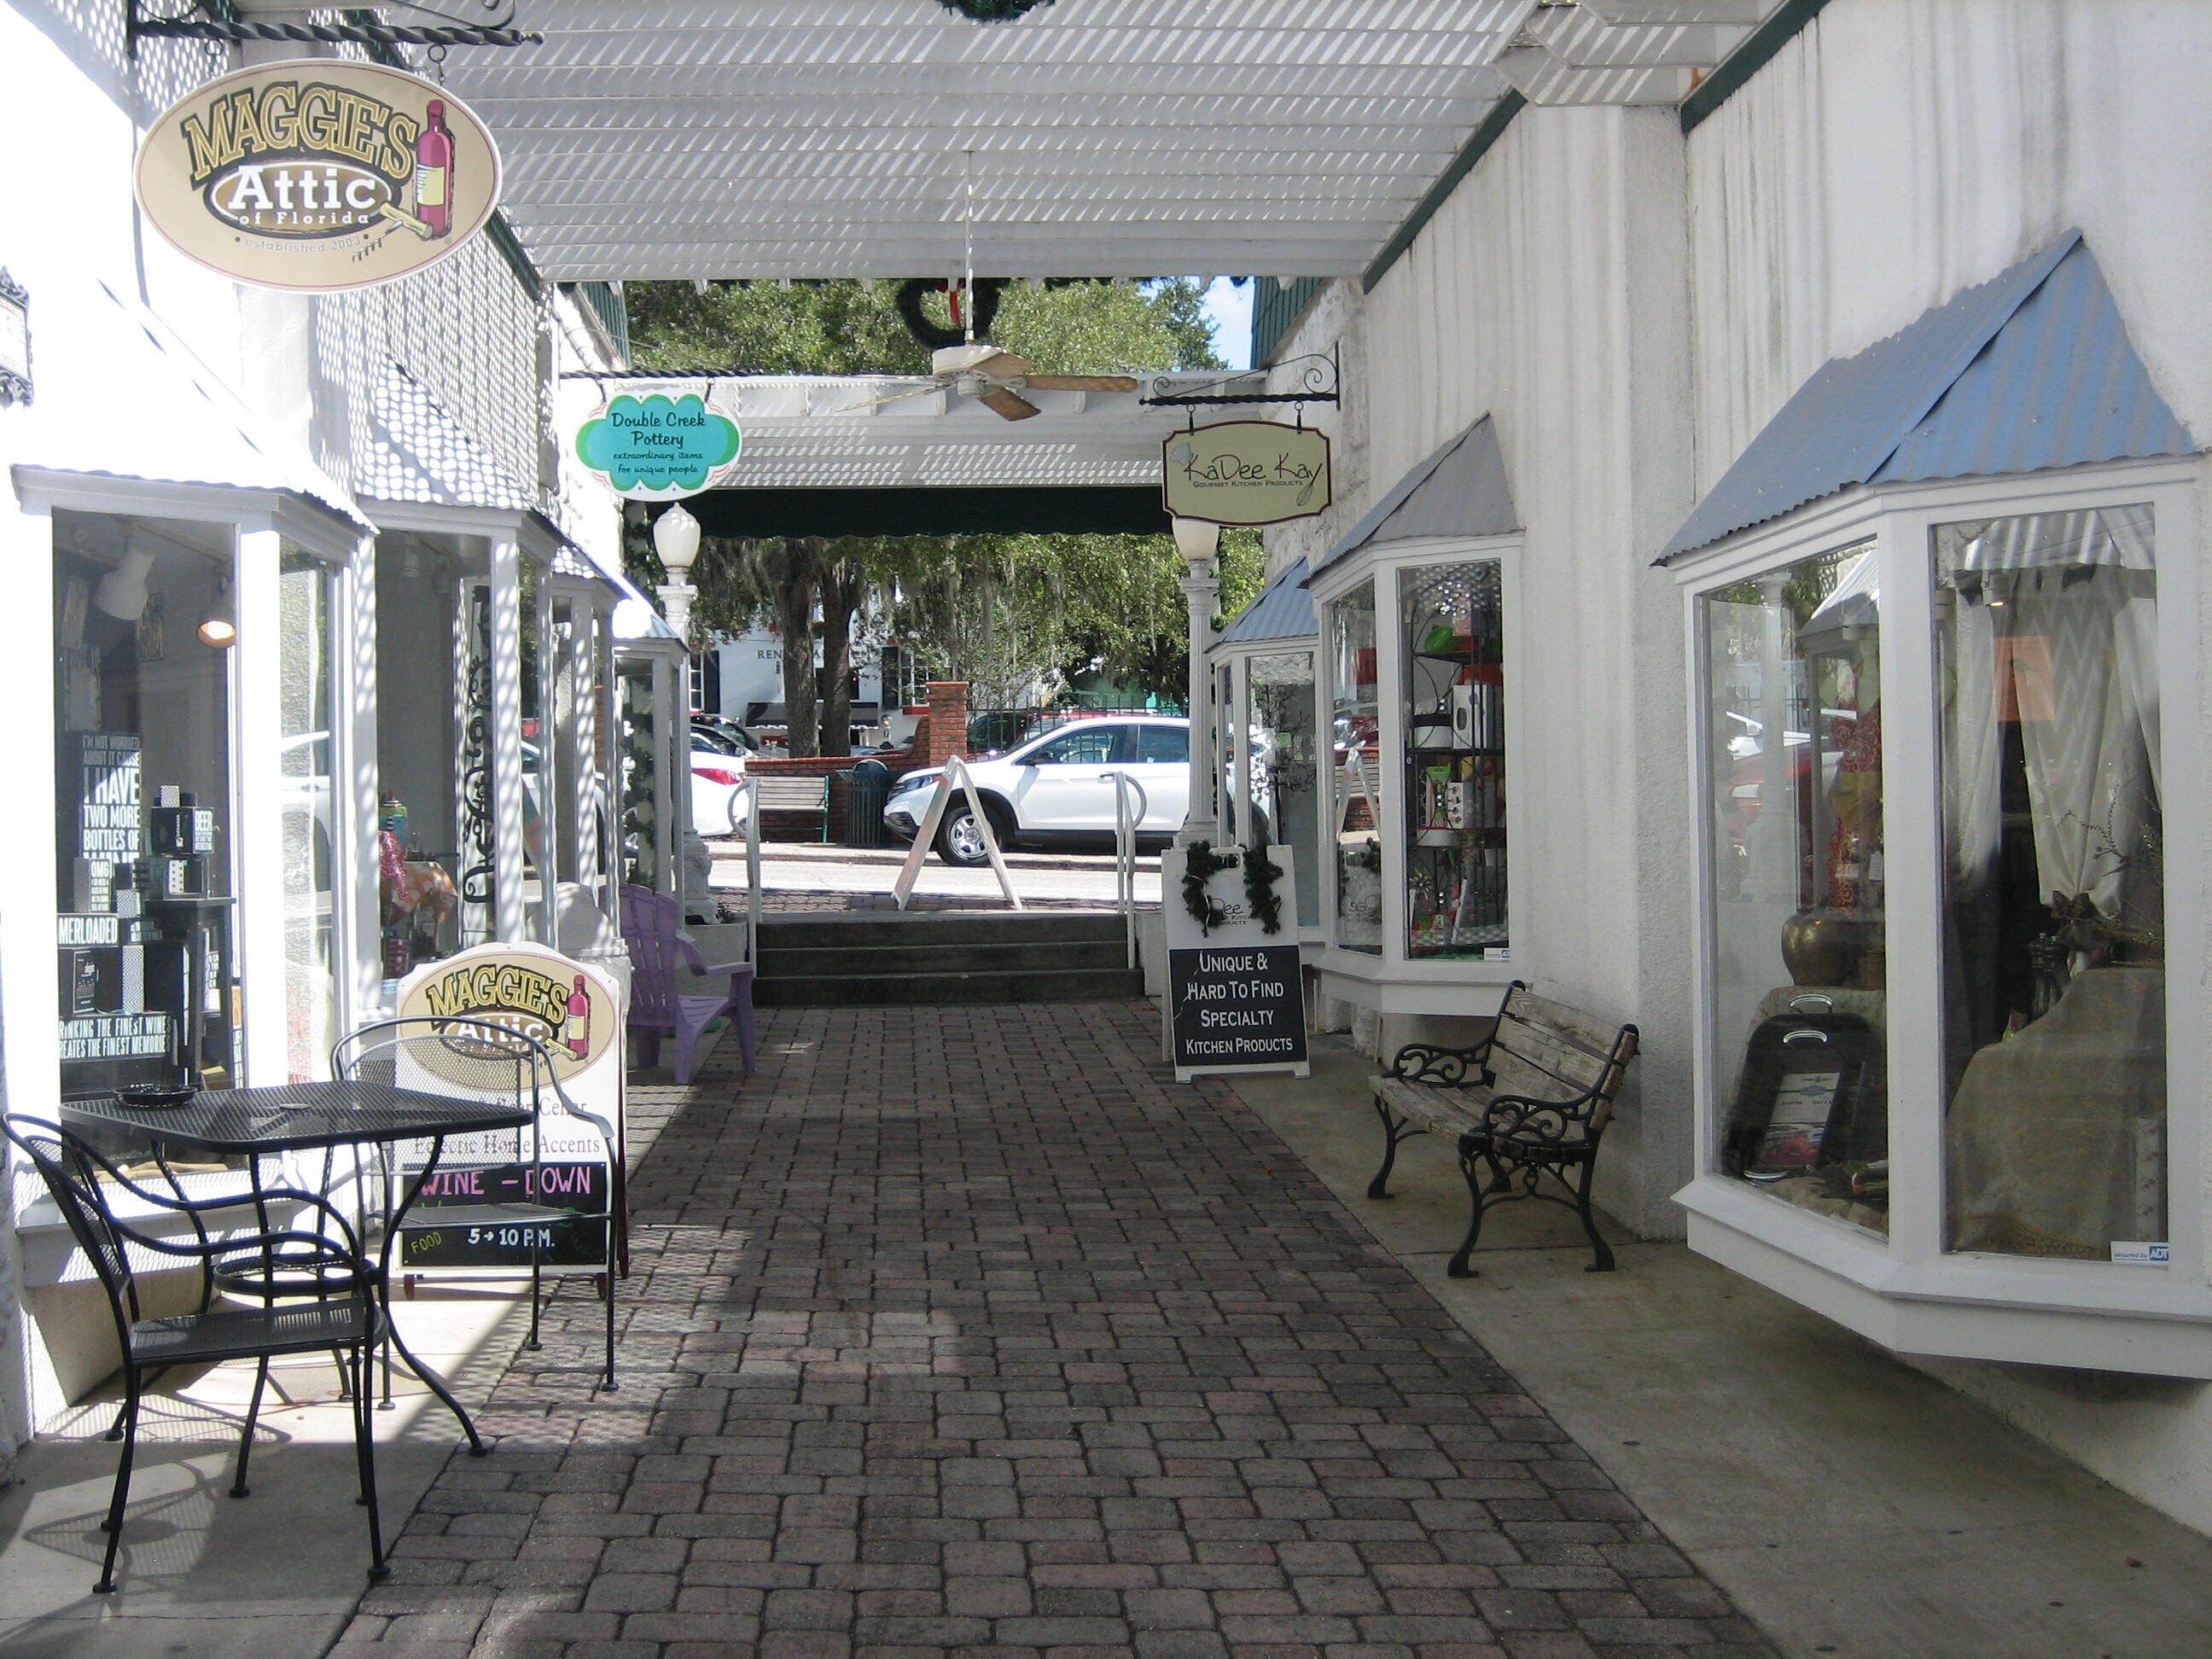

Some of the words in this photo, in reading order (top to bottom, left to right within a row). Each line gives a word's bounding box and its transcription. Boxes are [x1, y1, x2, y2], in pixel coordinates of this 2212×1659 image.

[182, 81, 420, 189] MAGGIE'S
[228, 166, 376, 210] Attic
[239, 212, 262, 225] of
[276, 211, 370, 225] Florida
[246, 237, 325, 253] established
[611, 410, 661, 428] Double
[666, 410, 706, 427] Creek
[631, 430, 684, 449] Pottery
[613, 451, 674, 461] extraordinary
[678, 451, 703, 459] items
[618, 464, 630, 474] for
[634, 466, 665, 475] unique
[668, 463, 698, 475] people
[1184, 453, 1266, 481] KaDee
[1274, 452, 1323, 498] Kay
[95, 767, 141, 805] HAVE
[83, 805, 108, 828] TWO
[110, 805, 141, 828] MORE
[195, 810, 212, 831] BEER
[83, 829, 125, 851] BOTTLES
[127, 829, 140, 850] OF
[90, 859, 109, 878] OMG
[58, 917, 118, 944] MERLOADED
[1199, 953, 1254, 973] UNIQUE
[1257, 952, 1268, 970] &
[427, 964, 569, 1029] MAGGIE'S
[1187, 981, 1226, 1000] HARD
[1228, 981, 1248, 998] TO
[1250, 980, 1284, 998] FIND
[96, 1018, 112, 1038] THE
[114, 1016, 143, 1036] FINEST
[1200, 1009, 1274, 1027] SPECIALTY
[87, 1038, 102, 1057] THE
[102, 1036, 131, 1057] FINEST
[1185, 1039, 1233, 1055] KITCHEN
[1235, 1037, 1294, 1053] PRODUCTS
[538, 1135, 600, 1153] Accents
[421, 1170, 484, 1196] WINE
[410, 1231, 443, 1254] FOOD
[468, 1227, 480, 1244] 5
[499, 1229, 519, 1246] 10
[2150, 1247, 2168, 1259] ADT
